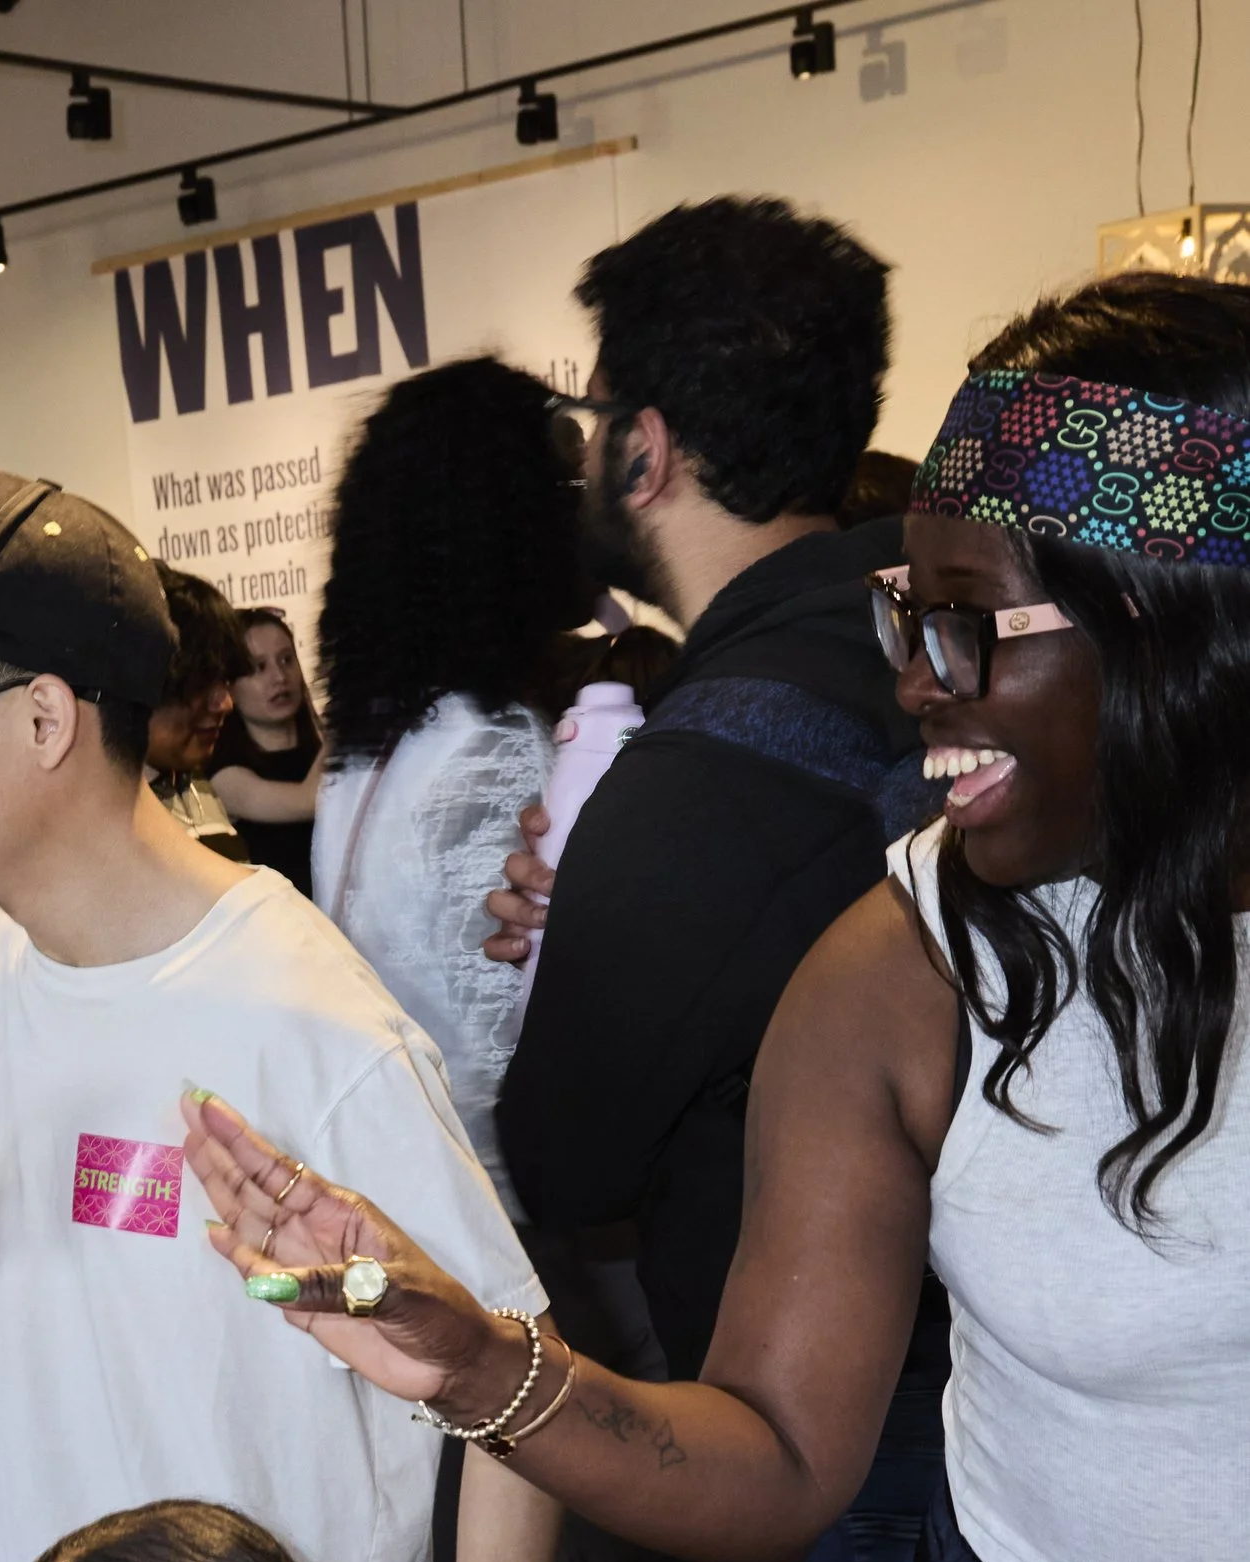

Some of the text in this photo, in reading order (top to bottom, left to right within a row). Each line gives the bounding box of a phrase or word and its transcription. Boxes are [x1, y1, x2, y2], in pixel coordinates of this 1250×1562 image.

[115, 201, 430, 424] WHEN
[153, 446, 321, 511] What was passed
[158, 525, 211, 562] down
[217, 526, 239, 554] as
[241, 560, 308, 602] remain
[79, 1168, 171, 1201] STRENGTH
